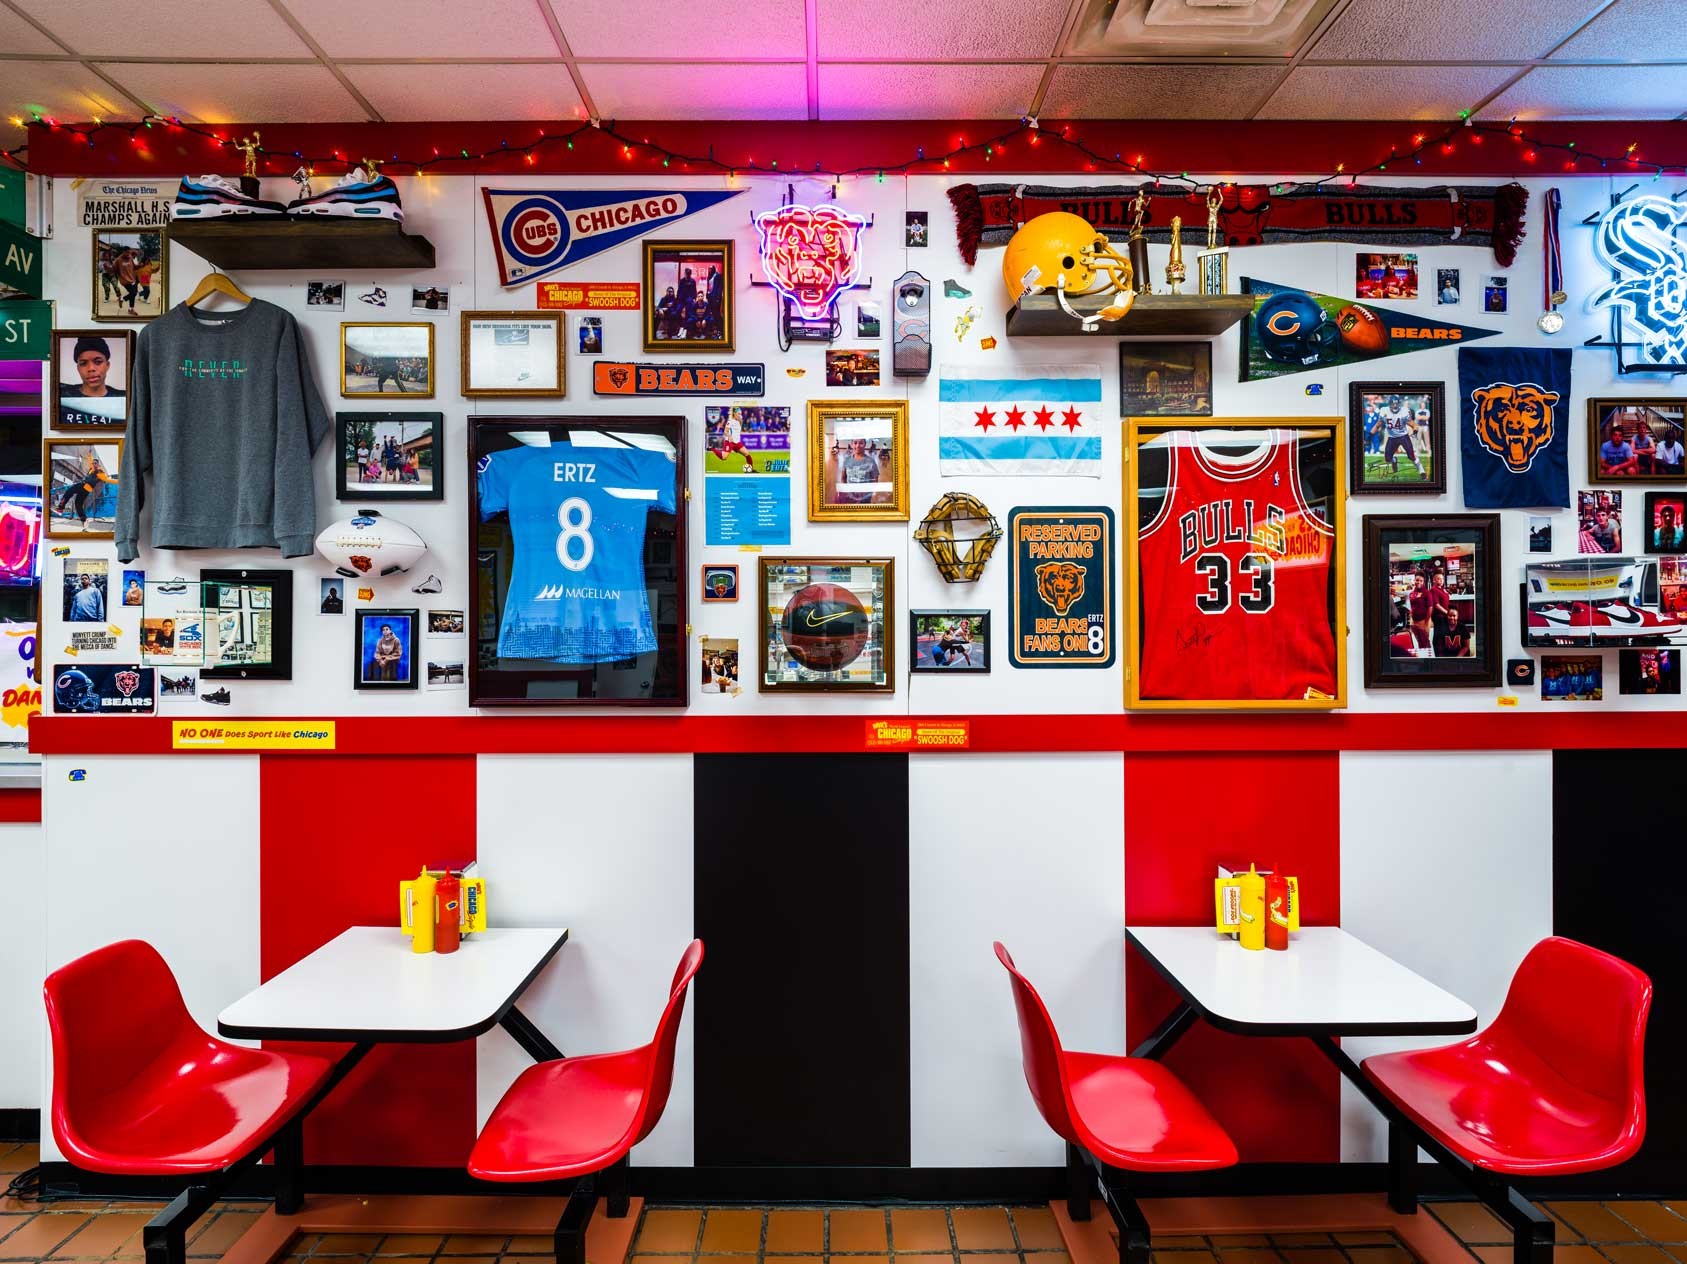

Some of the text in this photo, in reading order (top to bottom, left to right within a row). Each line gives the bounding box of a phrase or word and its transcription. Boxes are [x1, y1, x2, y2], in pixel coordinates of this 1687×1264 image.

[102, 186, 157, 195] The Chicago News
[85, 201, 147, 213] MARSHALL
[1325, 202, 1417, 225] BULLS
[84, 213, 170, 226] CHAMPS AGAIN
[575, 198, 678, 233] CHICAGO
[512, 210, 558, 255] CUBS
[5, 243, 33, 275] AV
[549, 290, 583, 301] CHICAGO
[5, 319, 31, 343] ST
[1390, 327, 1462, 340] BEARS
[639, 369, 756, 390] BEARS WAY
[1386, 418, 1401, 429] 54
[553, 462, 596, 483] ERTZ
[555, 496, 595, 572] 8
[1021, 525, 1101, 541] RESERVED
[1179, 499, 1286, 565] BULLS
[1029, 542, 1093, 559] PARKING
[1195, 553, 1275, 614] 33
[565, 588, 620, 600] MAGELLAN
[1035, 618, 1088, 634] BEARS
[1088, 614, 1104, 623] ERTZ
[1024, 635, 1088, 652] FANS ON
[1088, 626, 1104, 654] 8
[101, 698, 152, 706] BEARS
[179, 728, 196, 738] NO
[200, 728, 224, 738] ONE
[247, 731, 272, 739] Sport
[293, 730, 328, 739] Chicago
[878, 728, 912, 738] CHICAGO
